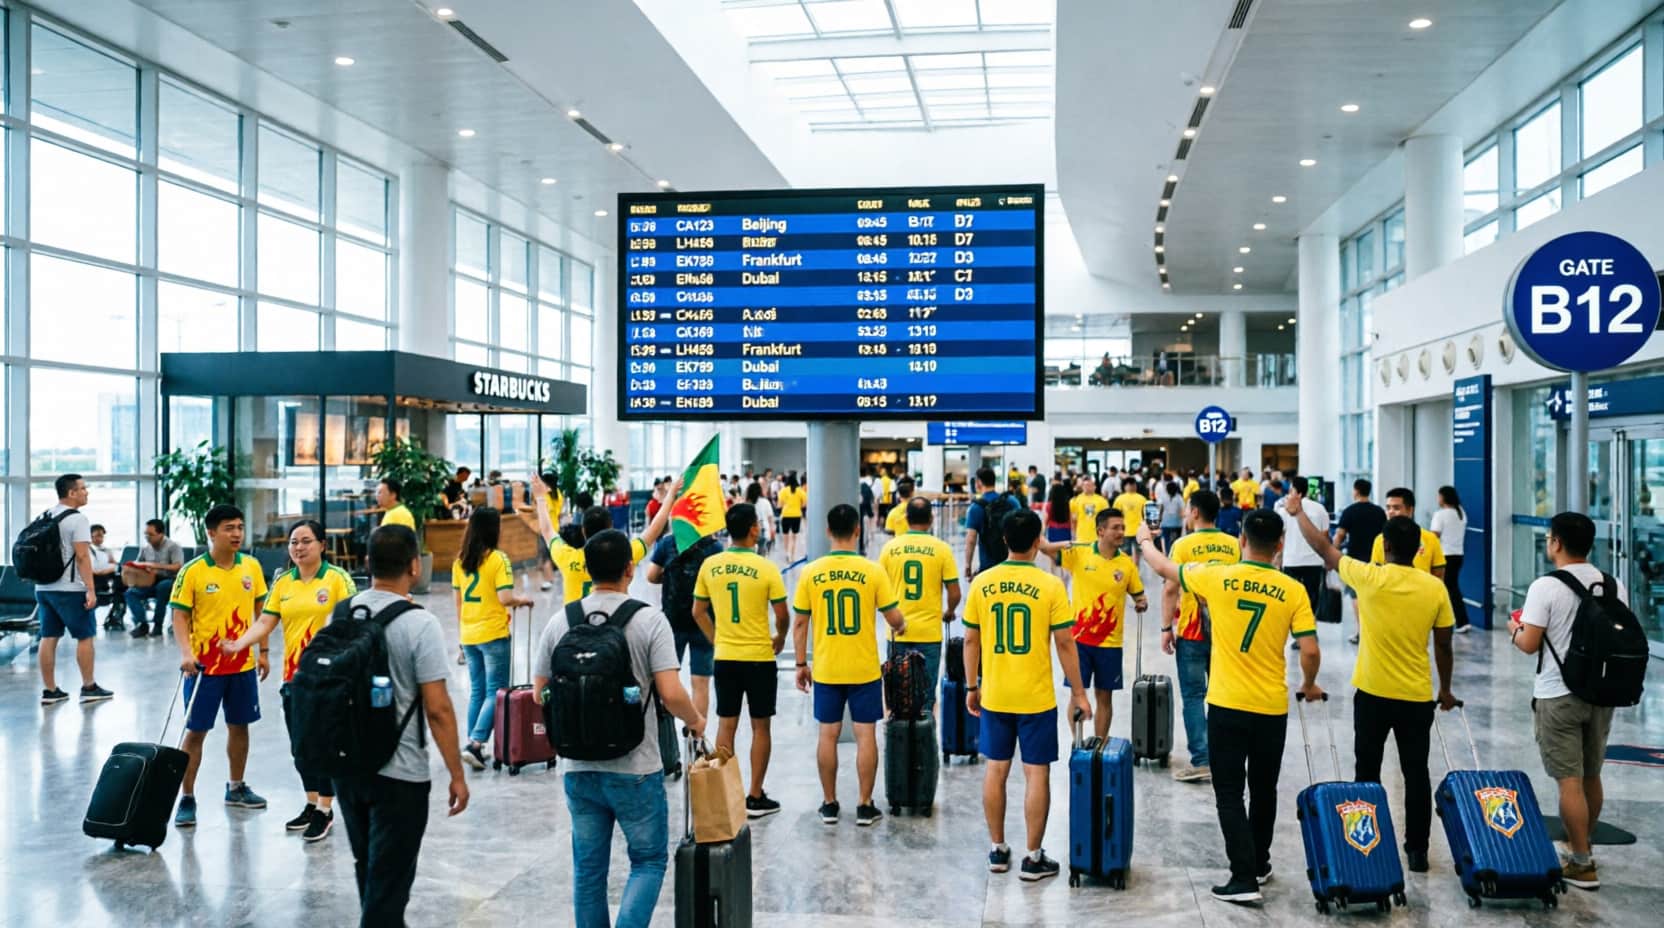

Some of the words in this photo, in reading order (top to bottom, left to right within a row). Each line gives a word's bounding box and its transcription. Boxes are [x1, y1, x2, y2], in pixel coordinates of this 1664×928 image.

[676, 219, 714, 232] CA123
[742, 217, 787, 233] Beijing
[954, 233, 974, 246] D7
[742, 253, 802, 267] Frankfurt
[1559, 258, 1614, 276] GATE
[742, 271, 780, 285] Dubai
[1531, 284, 1643, 334] B12
[742, 343, 802, 357] Frankfurt
[742, 360, 780, 373] Dubai
[474, 371, 550, 403] STARBUCKS
[742, 396, 779, 408] Dubai
[1199, 419, 1227, 433] B12
[711, 566, 723, 577] FC
[725, 564, 759, 580] BRAZIL
[813, 573, 826, 585] FC
[829, 570, 867, 585] BRAZIL
[903, 560, 923, 600] 9
[463, 570, 481, 603] 2
[982, 584, 997, 598] FC
[1000, 581, 1040, 600] BRAZIL
[1223, 579, 1239, 591] FC
[1243, 580, 1286, 602] BRAZIL
[726, 581, 740, 624] 1
[822, 588, 861, 636] 10
[991, 602, 1032, 655] 10
[1237, 598, 1267, 653] 7
